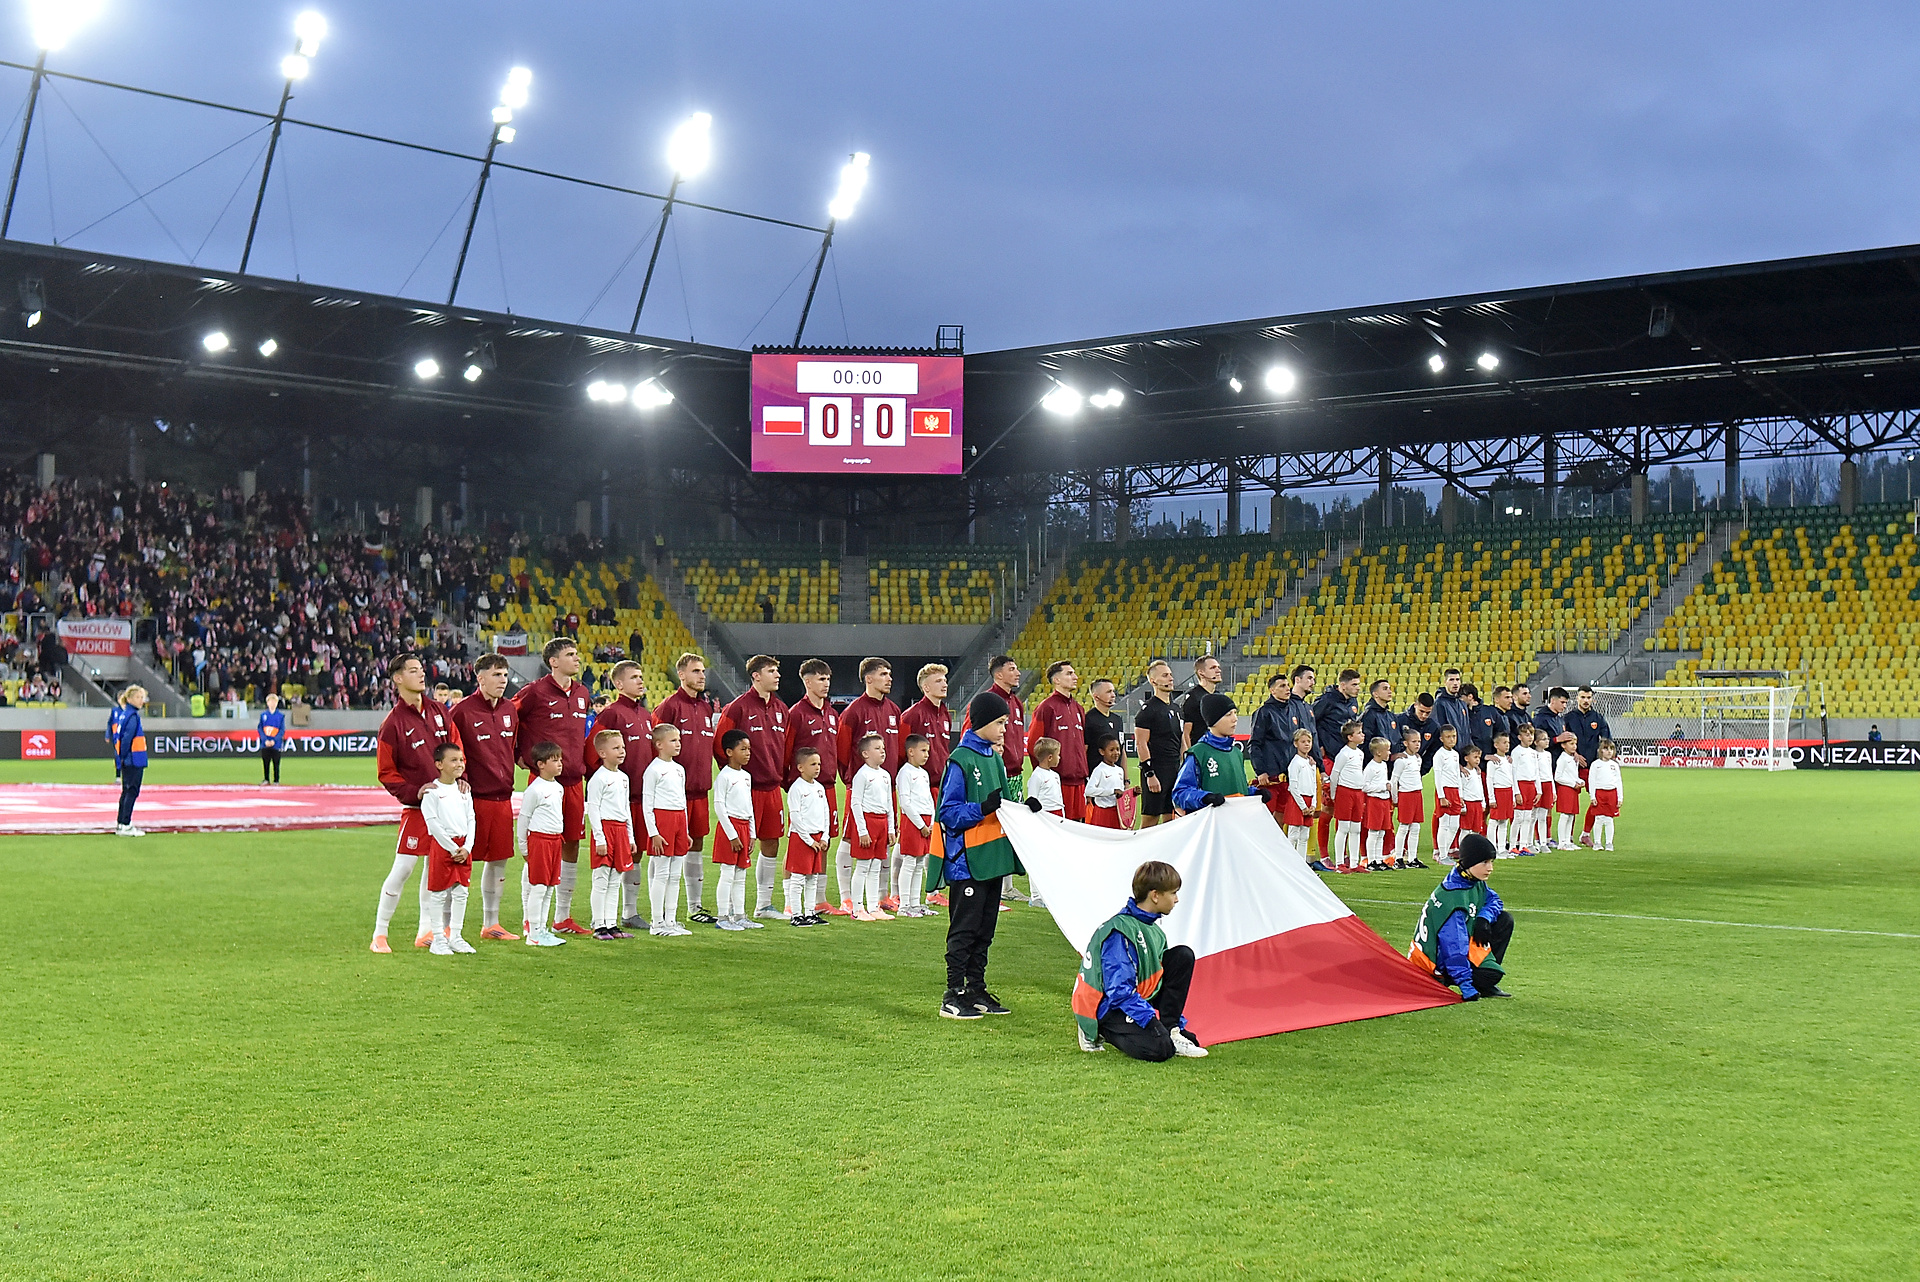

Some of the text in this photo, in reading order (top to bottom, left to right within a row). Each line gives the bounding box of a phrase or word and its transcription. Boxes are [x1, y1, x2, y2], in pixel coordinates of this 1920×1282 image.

[833, 369, 882, 385] 00:00
[822, 403, 839, 439] 0
[876, 403, 893, 439] 0
[75, 639, 117, 653] MOKRE
[154, 736, 234, 753] ENERGIA
[300, 736, 326, 752] TO
[1623, 757, 1650, 765] ORLEN
[1751, 759, 1780, 767] ORLN
[1776, 747, 1805, 763] TO
